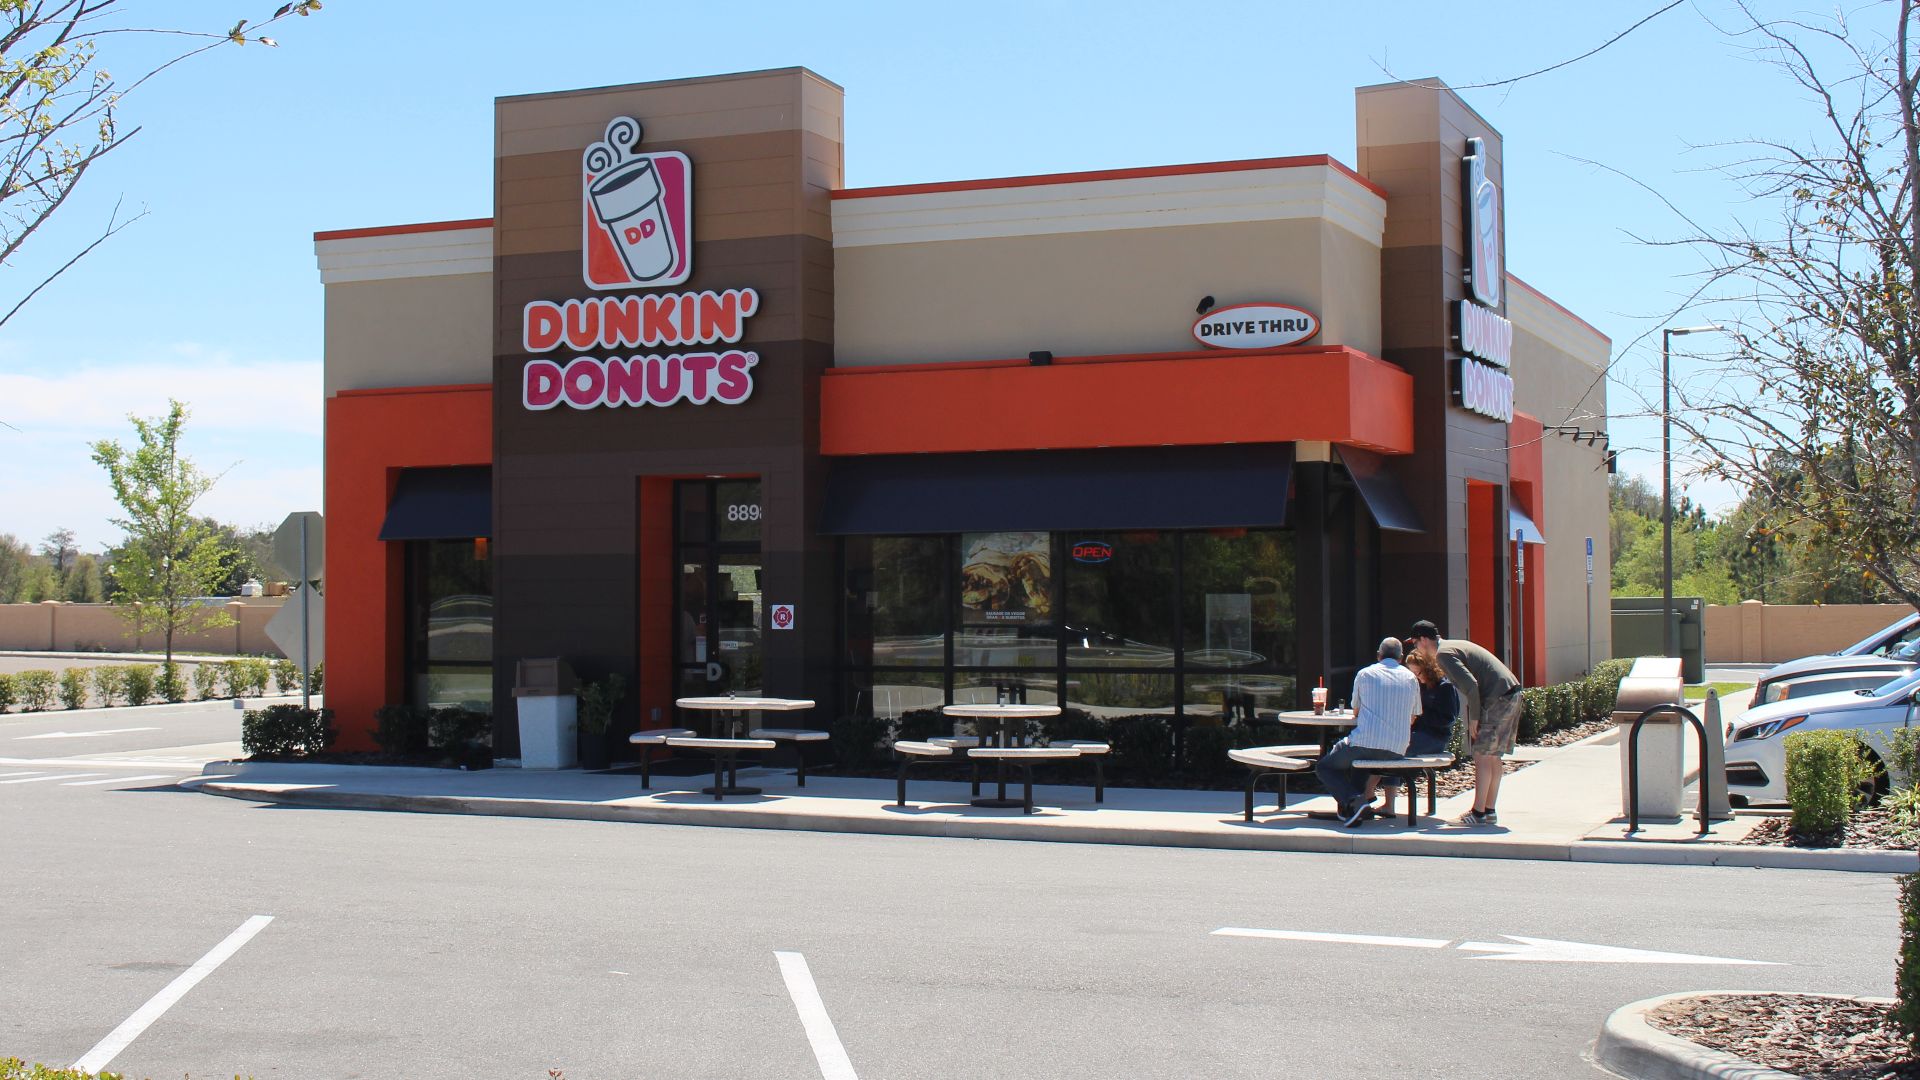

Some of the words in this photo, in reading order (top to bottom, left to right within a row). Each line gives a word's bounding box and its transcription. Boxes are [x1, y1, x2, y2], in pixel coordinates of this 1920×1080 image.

[624, 219, 656, 245] DD
[526, 290, 754, 349] DUNKIN'
[1201, 321, 1255, 337] DRIVE
[1258, 318, 1309, 333] THRU
[1462, 358, 1514, 424] DONUTS
[727, 504, 762, 521] 889
[1072, 547, 1113, 557] OPEN
